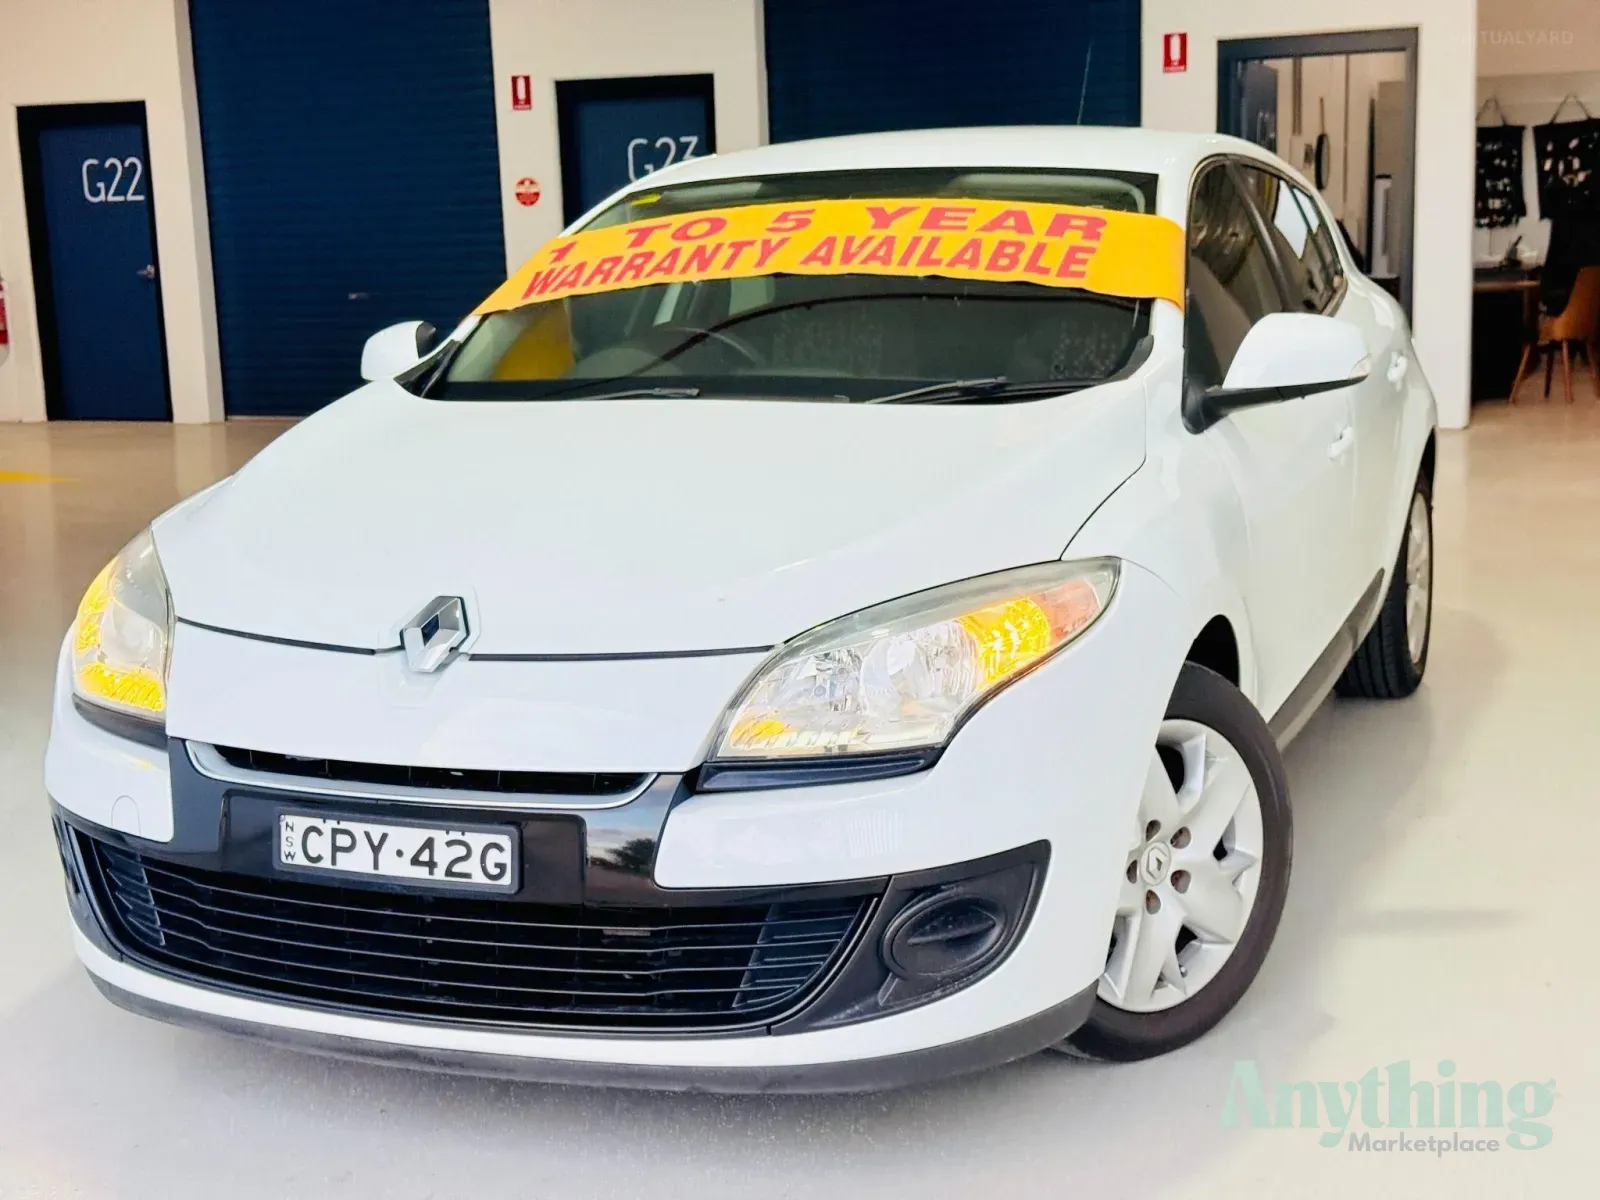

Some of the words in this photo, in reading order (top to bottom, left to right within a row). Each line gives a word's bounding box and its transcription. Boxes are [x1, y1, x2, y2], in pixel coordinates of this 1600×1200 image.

[81, 156, 146, 203] G22
[548, 240, 579, 264] 1
[625, 216, 728, 249] TO
[765, 208, 816, 234] 5
[865, 206, 1108, 242] YEAR
[520, 236, 792, 300] WARRANTY
[799, 235, 1098, 279] AVAILABLE
